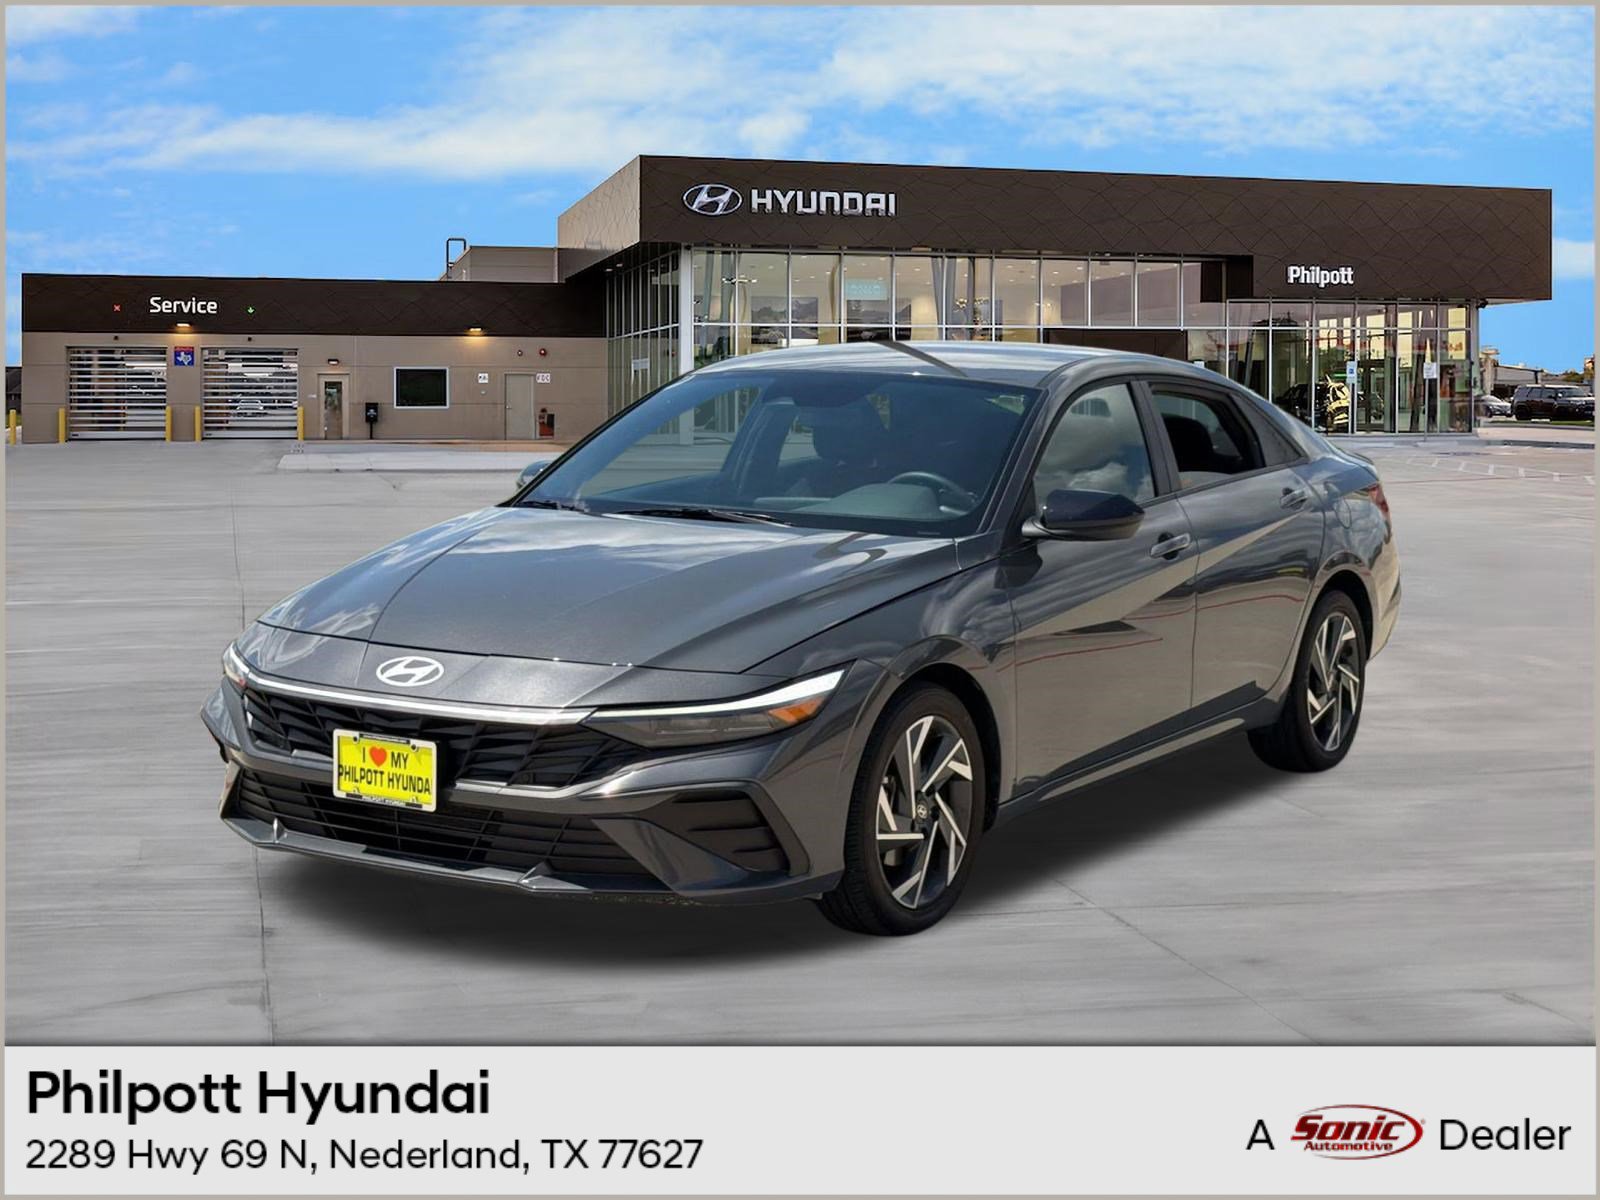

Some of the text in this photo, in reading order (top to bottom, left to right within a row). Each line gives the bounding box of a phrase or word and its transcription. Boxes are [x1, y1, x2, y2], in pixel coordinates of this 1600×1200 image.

[750, 188, 897, 217] HYUNDAI
[1287, 265, 1355, 288] Philpott
[149, 296, 218, 314] Service
[362, 747, 409, 770] I MY
[338, 764, 433, 795] PHILPOTT HYUNDA
